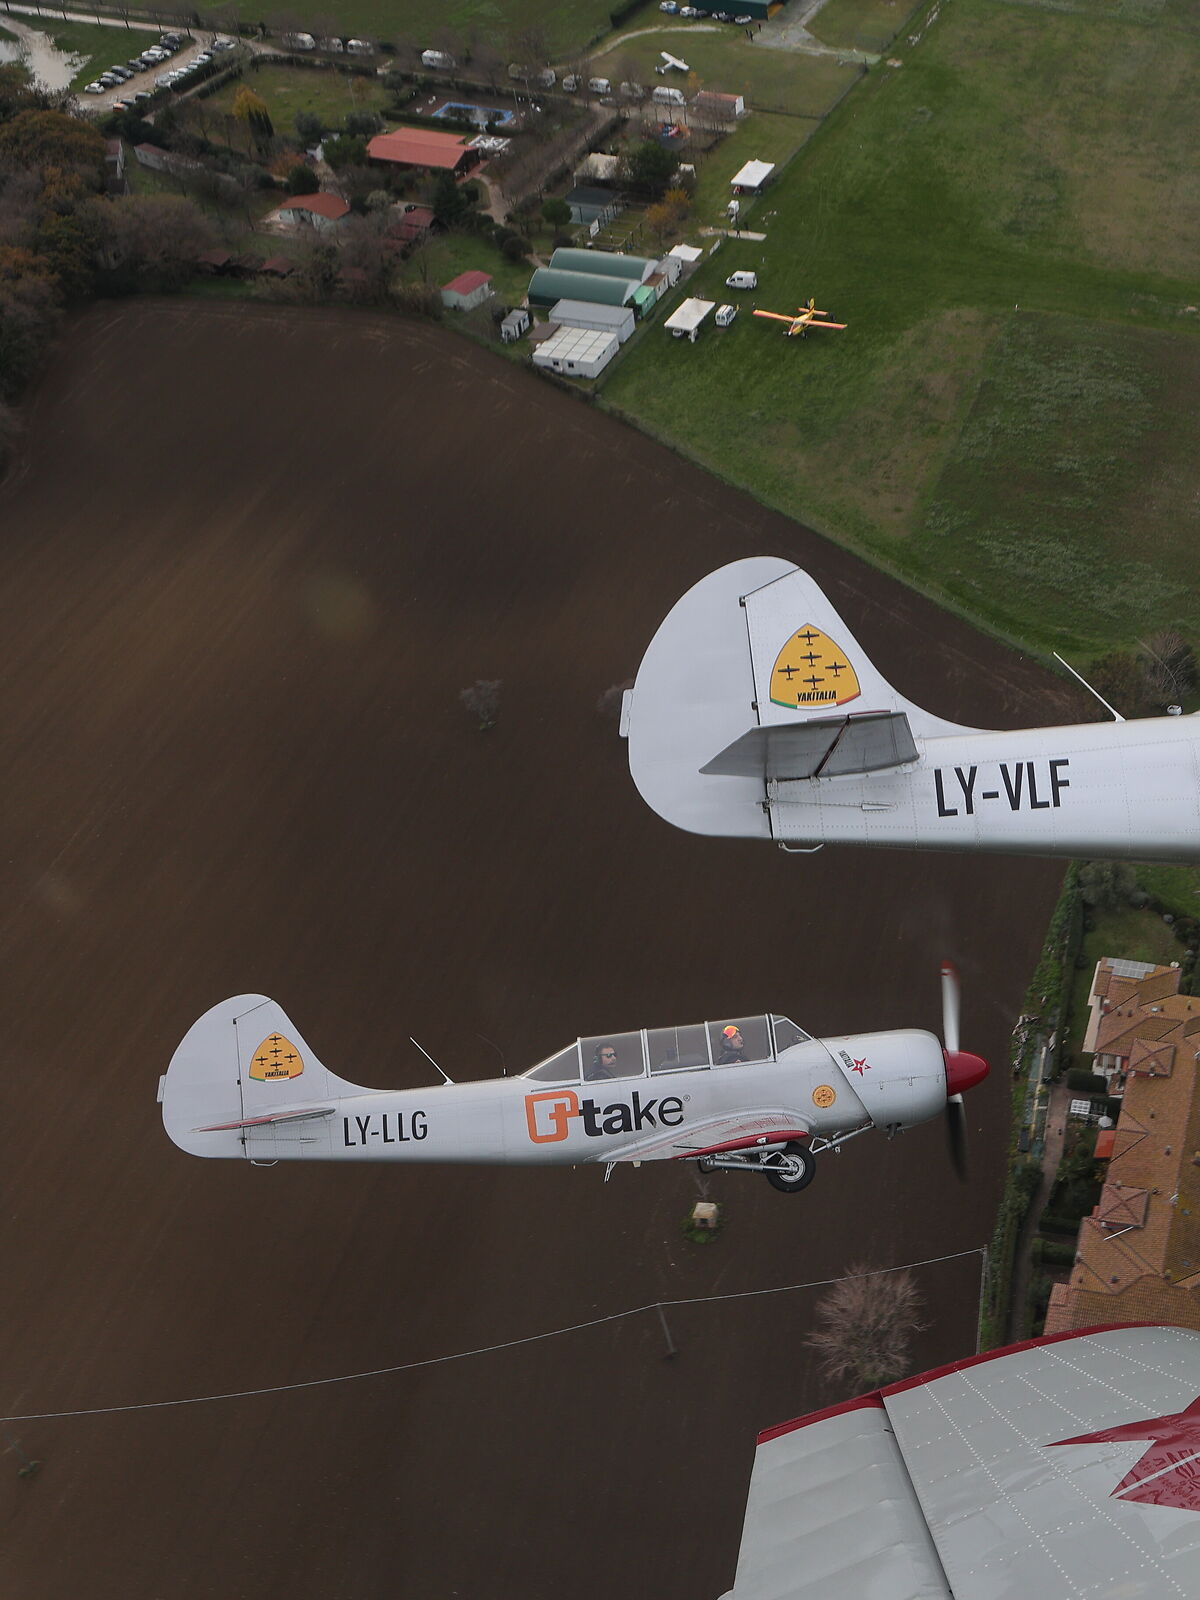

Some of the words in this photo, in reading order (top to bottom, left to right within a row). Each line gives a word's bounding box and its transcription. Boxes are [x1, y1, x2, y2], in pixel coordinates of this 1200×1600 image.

[797, 690, 837, 702] YAKITALIA
[934, 758, 1070, 817] LY-VLF
[343, 1110, 428, 1147] LY-LLG
